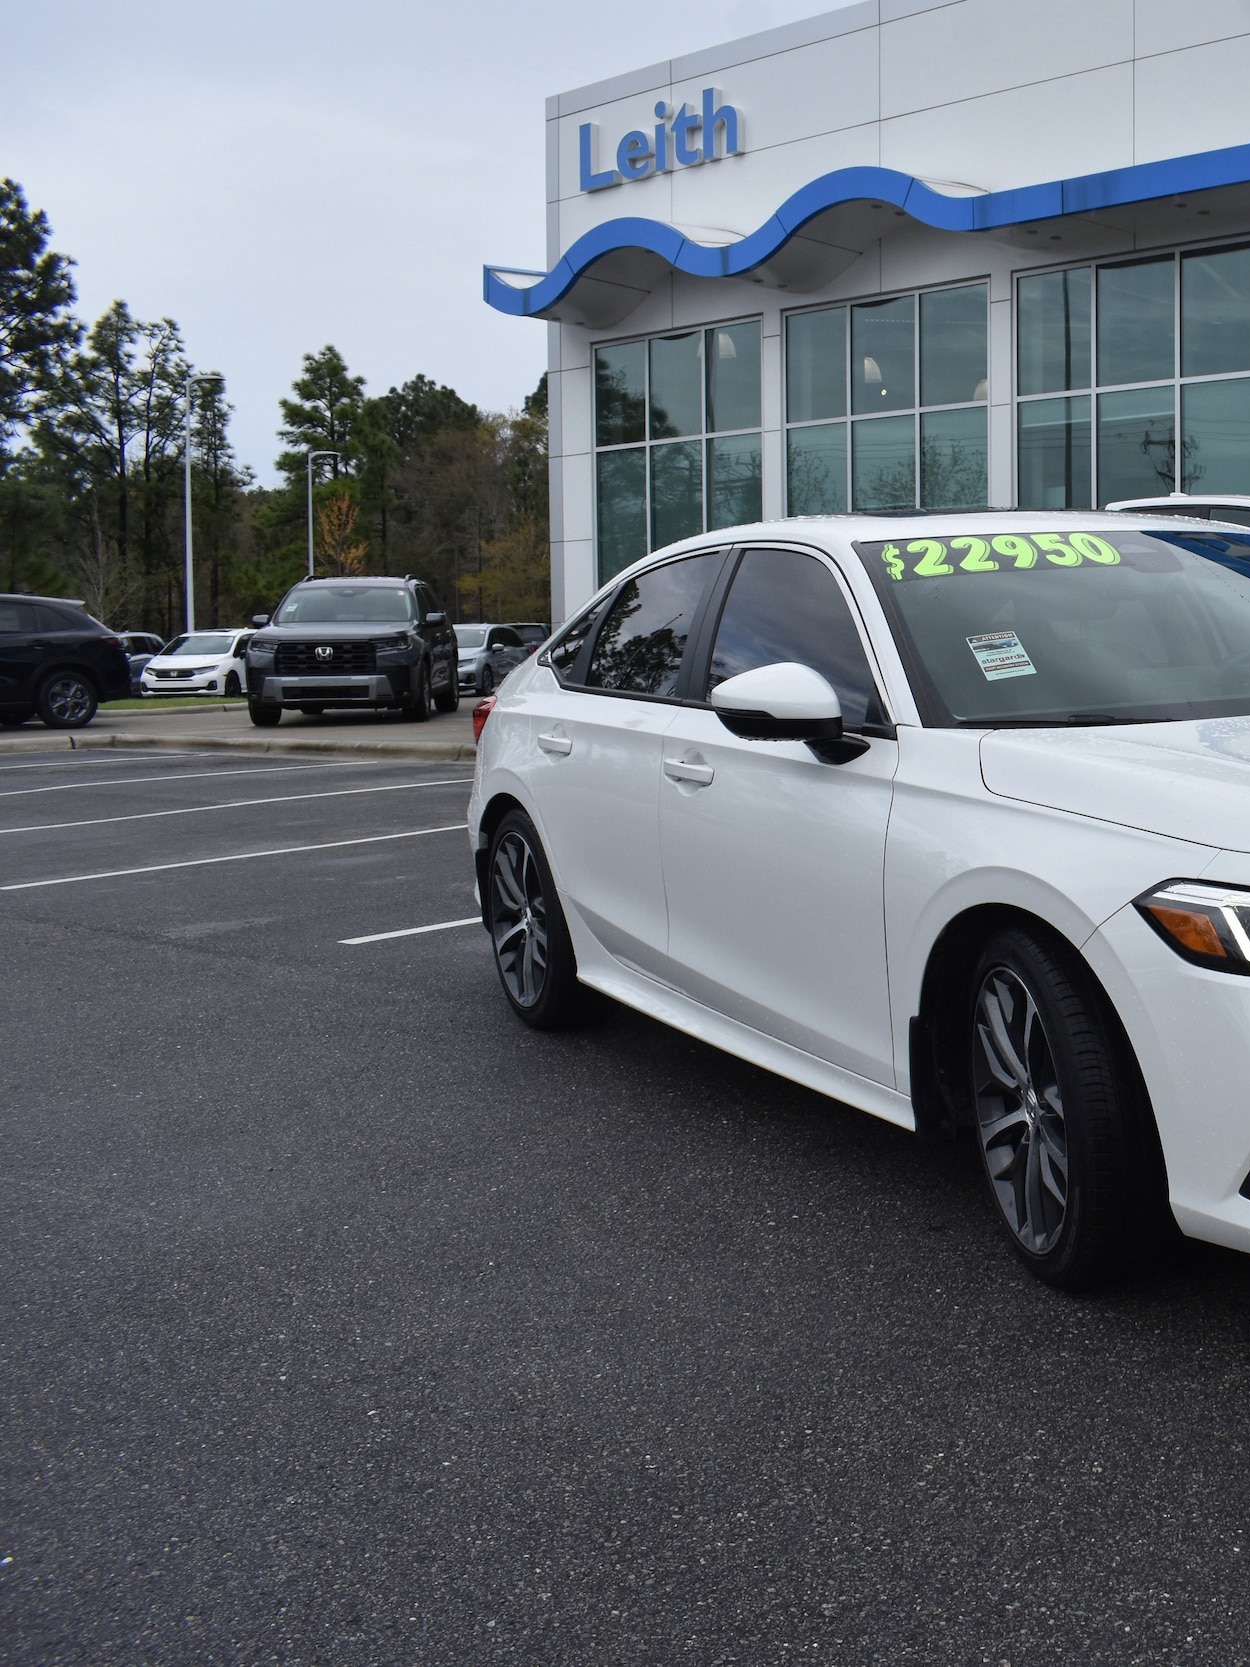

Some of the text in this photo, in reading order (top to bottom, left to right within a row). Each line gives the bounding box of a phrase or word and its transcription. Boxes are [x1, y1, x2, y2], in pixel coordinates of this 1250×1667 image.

[579, 87, 743, 192] Leith
[881, 532, 1121, 580] $22950
[981, 633, 1013, 641] ATTENTION
